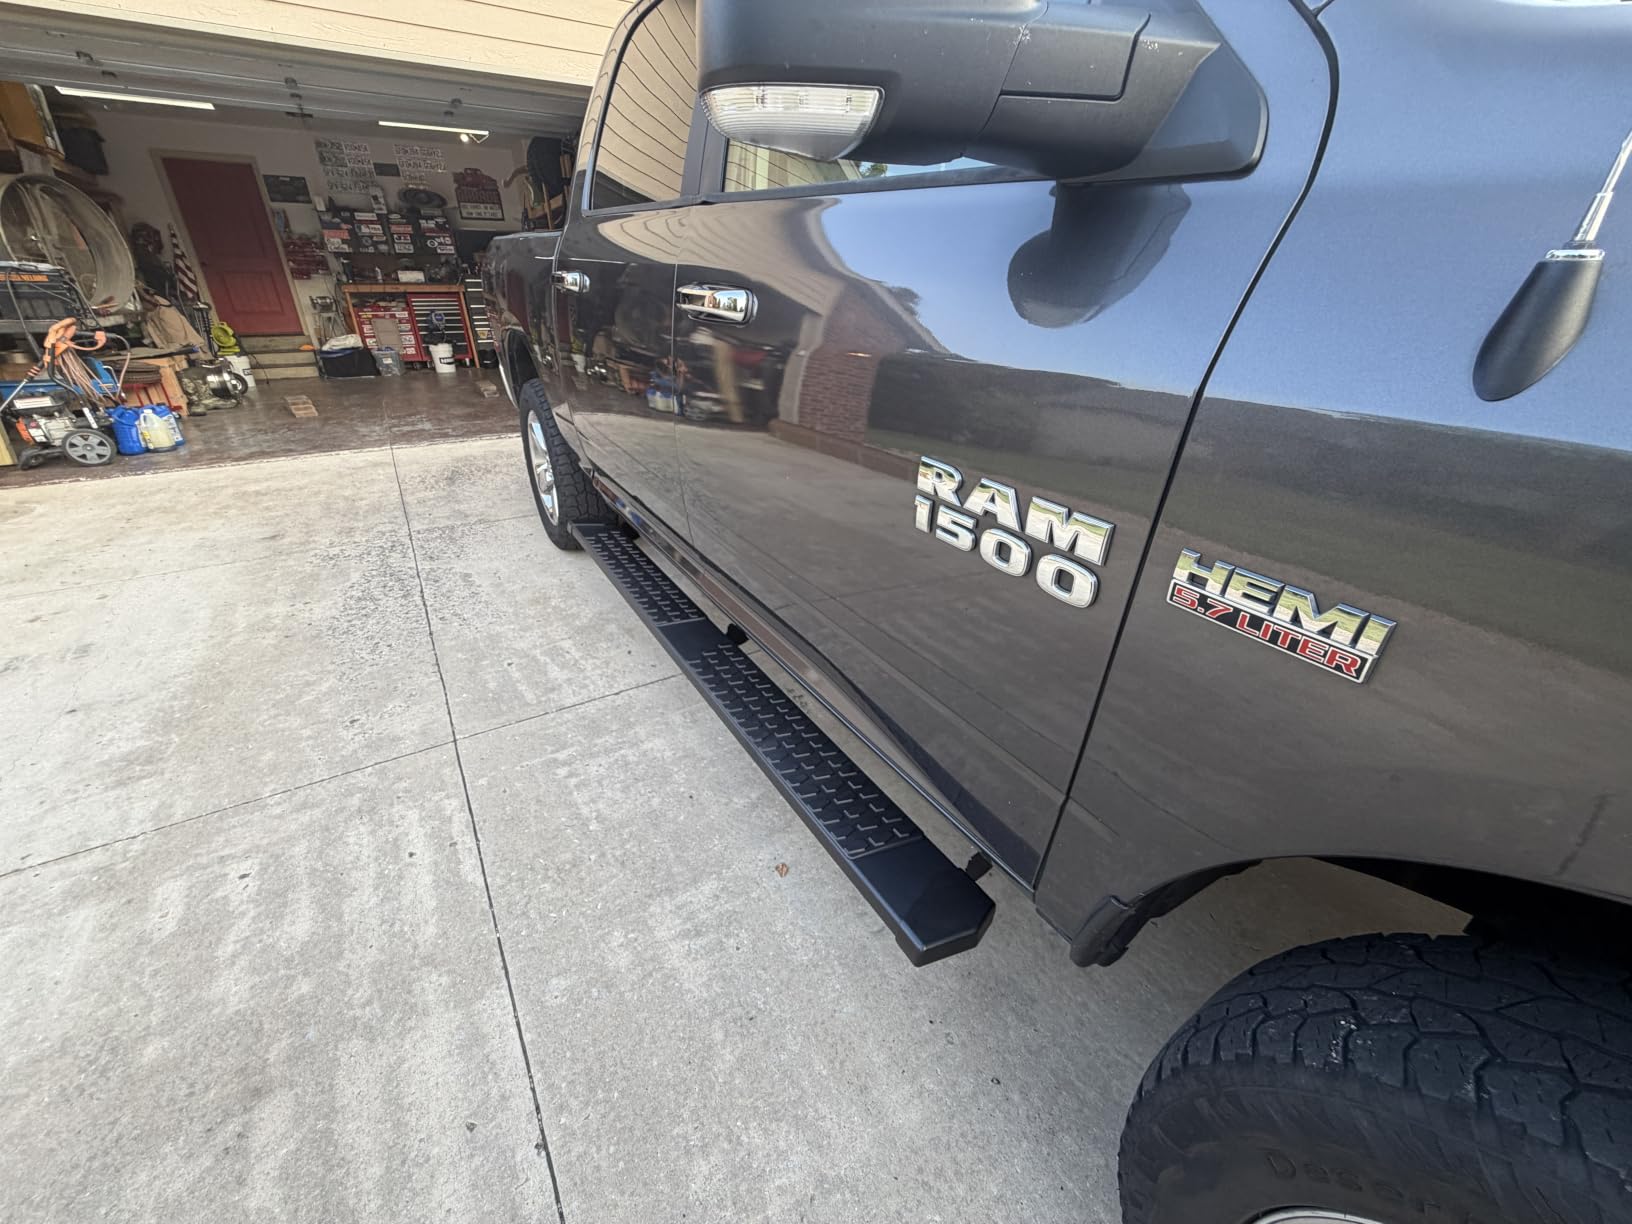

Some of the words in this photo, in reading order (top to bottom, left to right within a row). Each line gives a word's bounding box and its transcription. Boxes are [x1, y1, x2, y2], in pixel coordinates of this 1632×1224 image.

[914, 494, 1099, 608] 1500
[918, 455, 1115, 566] RAM
[1172, 547, 1398, 656] HEMI
[1173, 586, 1233, 618] 5.7
[1237, 612, 1363, 677] LITER
